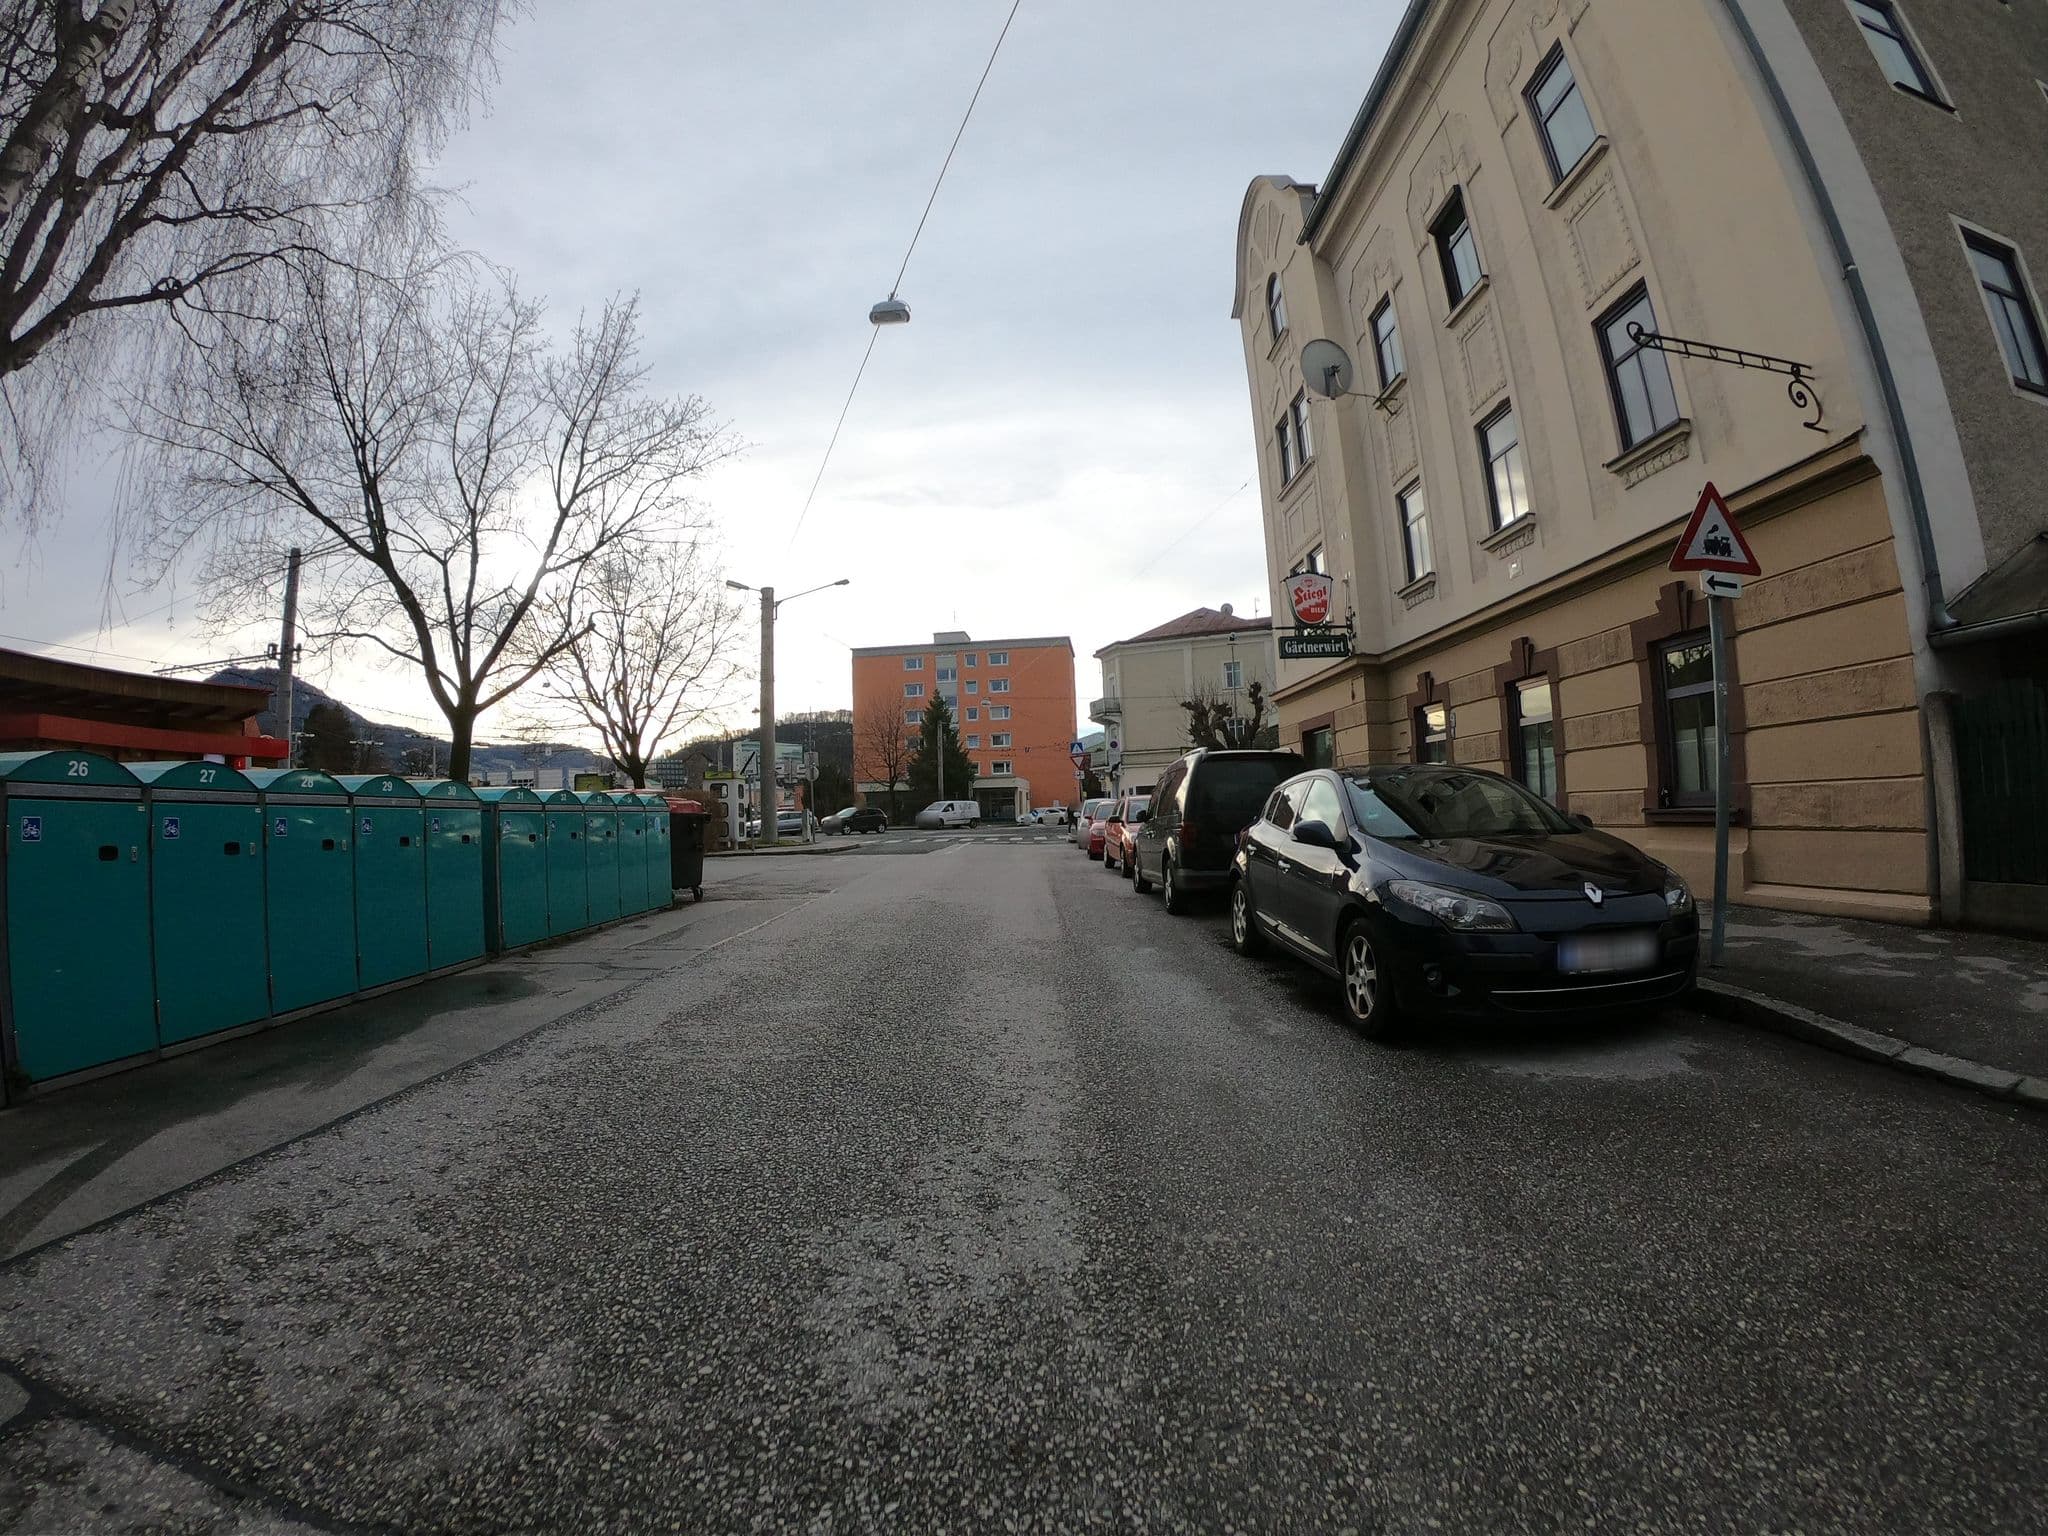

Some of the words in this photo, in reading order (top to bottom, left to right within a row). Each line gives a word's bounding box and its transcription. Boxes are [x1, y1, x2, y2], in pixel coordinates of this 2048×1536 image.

[1294, 586, 1327, 607] Stiegl
[1285, 640, 1345, 654] Gärtnerwirt
[68, 760, 89, 777] 26
[199, 769, 216, 783] 27
[301, 776, 314, 788] 28
[382, 781, 393, 792] 29
[447, 786, 457, 796] 30
[23, 818, 29, 826] P
